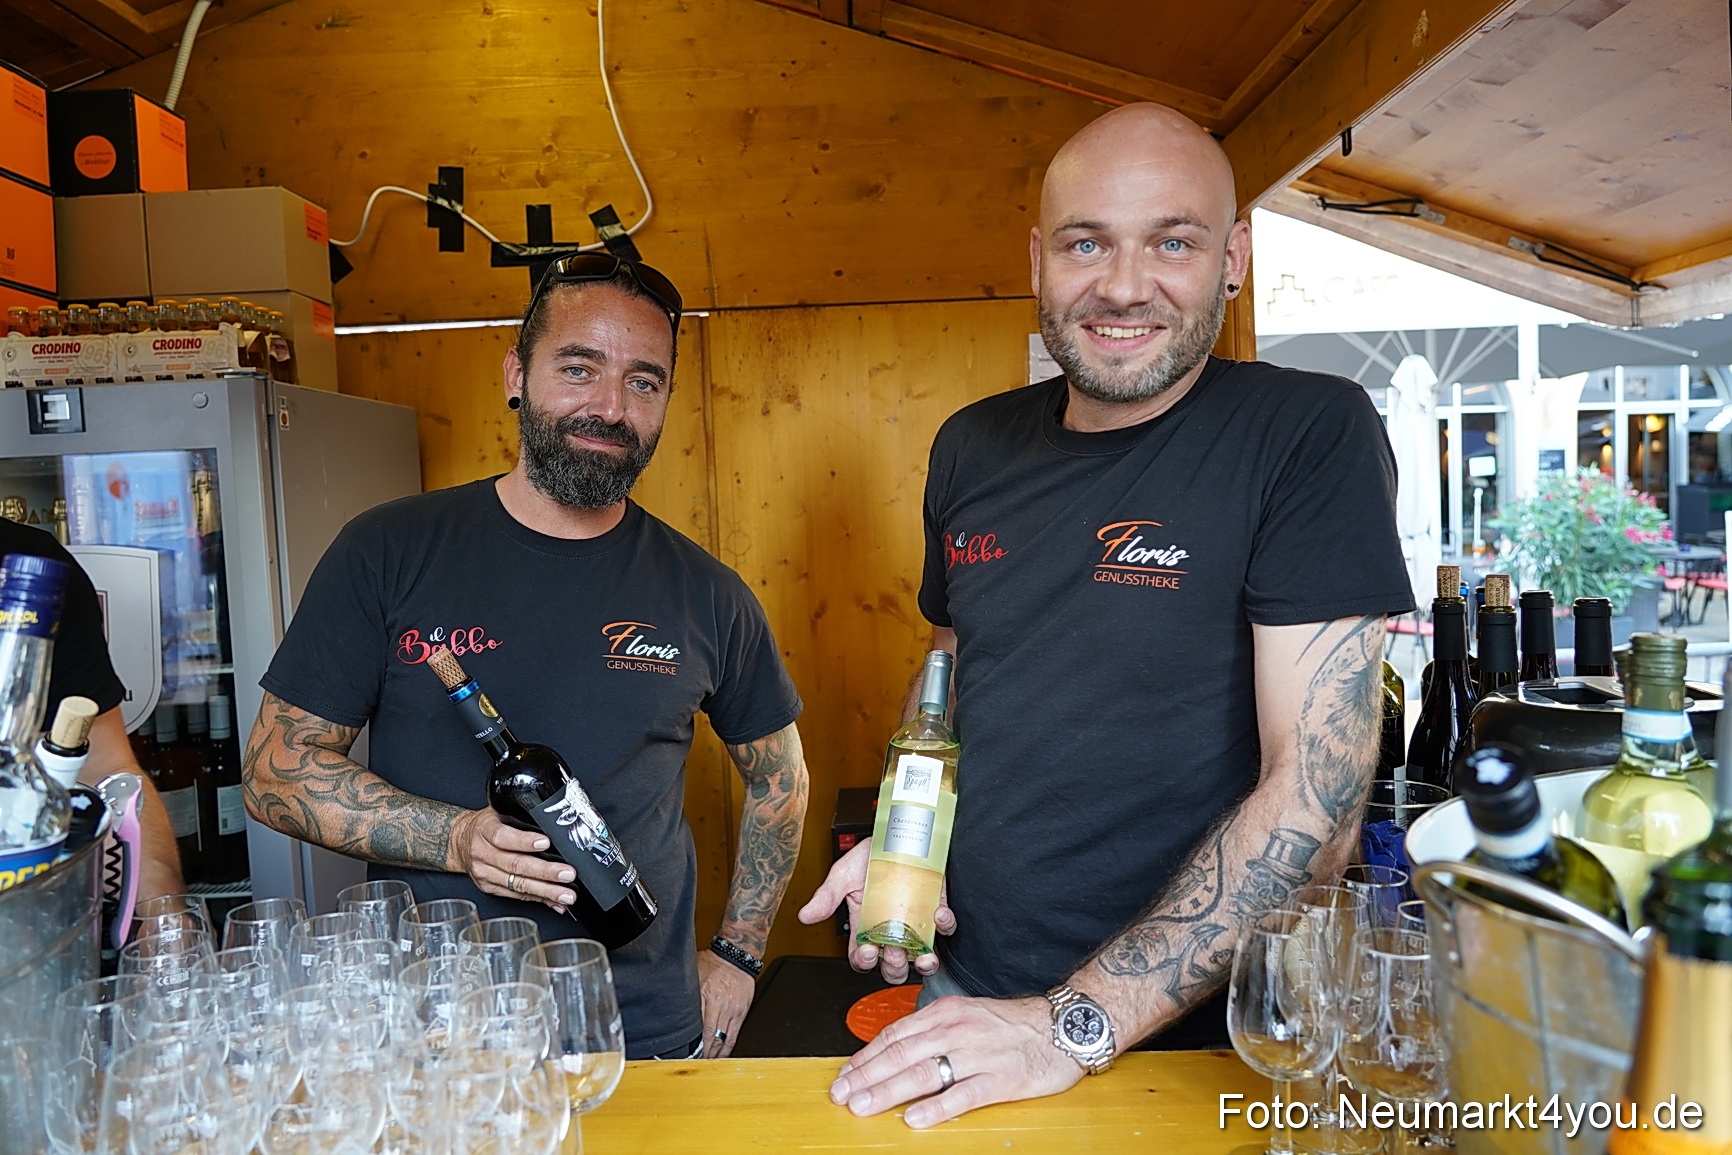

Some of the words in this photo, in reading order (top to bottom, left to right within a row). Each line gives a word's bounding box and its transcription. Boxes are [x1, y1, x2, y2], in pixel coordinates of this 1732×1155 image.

[32, 342, 82, 355] CRODINO
[152, 337, 203, 351] CRODINO
[1096, 520, 1190, 567] Floris
[1093, 570, 1181, 590] GENUSSTHEKE
[601, 621, 681, 660] Floris
[606, 660, 677, 676] GENUSSTHEKE
